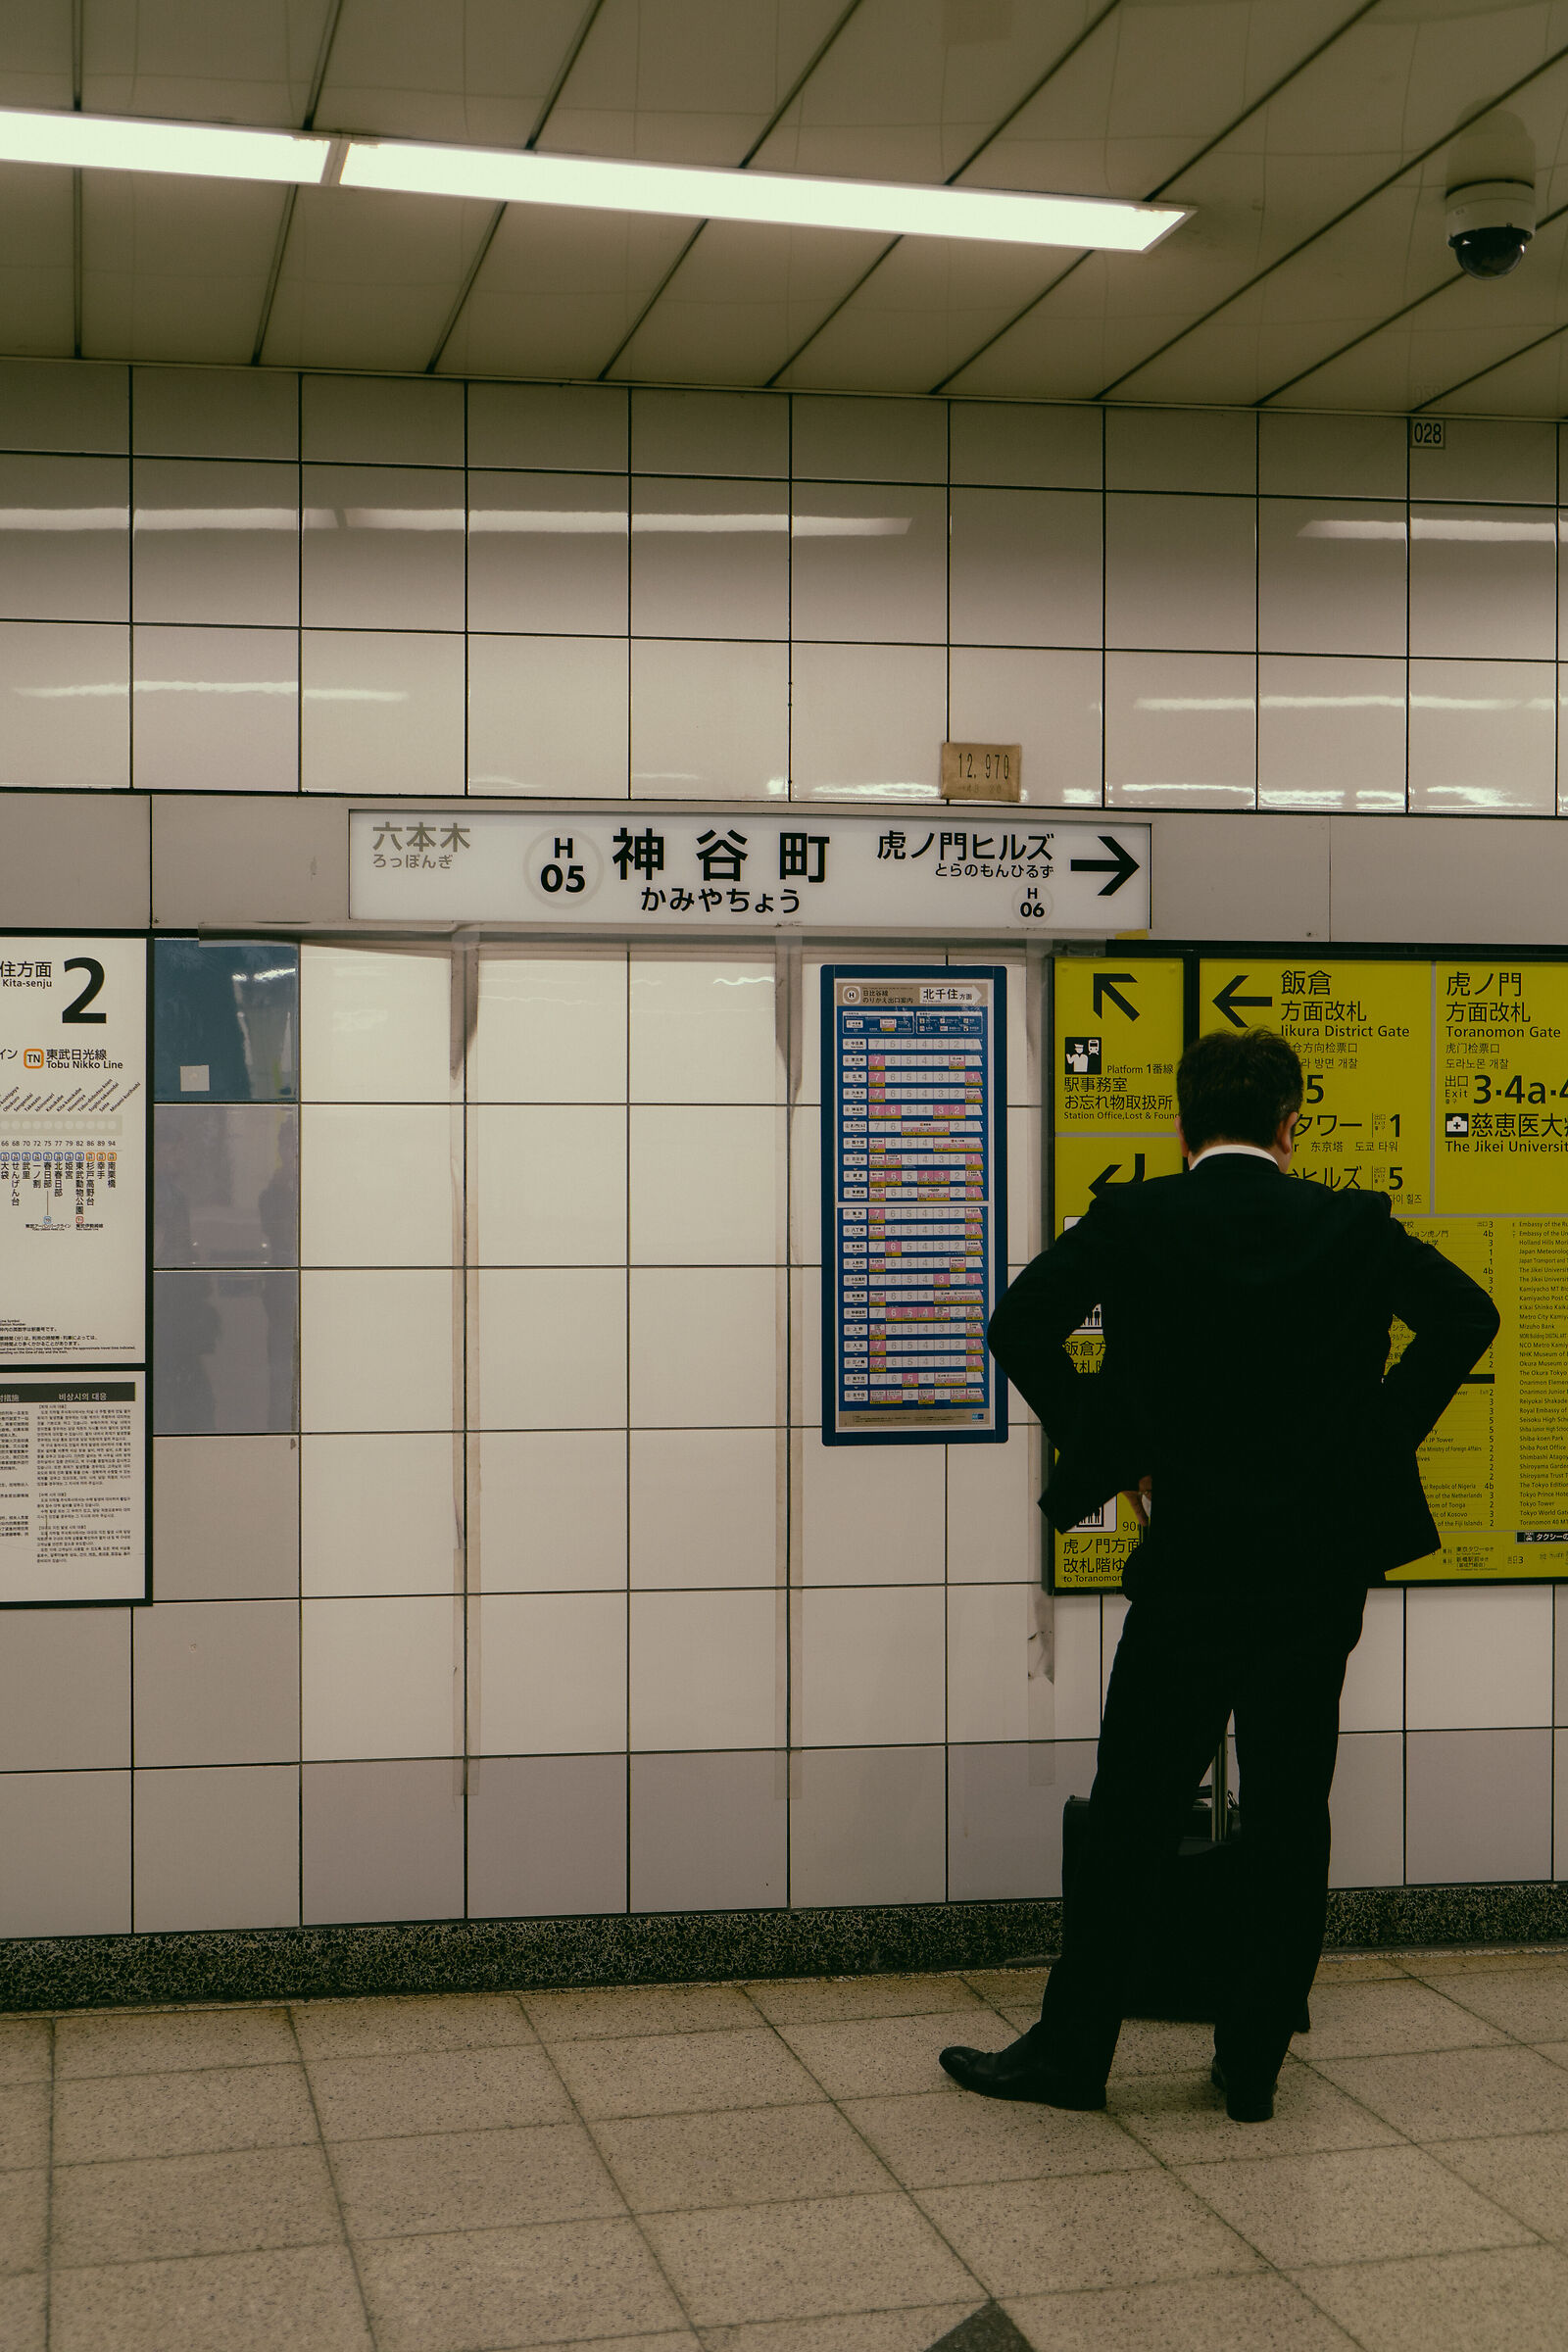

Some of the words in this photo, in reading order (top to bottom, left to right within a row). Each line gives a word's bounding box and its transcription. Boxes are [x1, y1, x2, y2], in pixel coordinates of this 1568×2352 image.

[1414, 422, 1442, 444] 028
[372, 821, 470, 853] 六本木
[554, 838, 573, 858] H
[877, 830, 1054, 860] 虎ノ門ヒルズ
[372, 854, 453, 869] ろっぽんぎ
[612, 827, 830, 883] 神谷町
[935, 863, 1054, 878] とらのもんひるず
[541, 864, 585, 893] 05
[641, 887, 800, 913] かみやちょう
[1028, 888, 1038, 899] H
[1020, 902, 1045, 917] 06
[0, 960, 52, 977] 住方面
[2, 979, 52, 989] Kita-senju
[63, 957, 107, 1023] 2
[1281, 970, 1332, 995] 飯倉
[1446, 971, 1522, 997] 虎ノ門
[923, 989, 957, 1000] 北千住
[1281, 1001, 1367, 1022] 方面改札
[1446, 1002, 1531, 1022] 方面改札
[1281, 1025, 1319, 1037] Iikura
[1325, 1025, 1373, 1037] District
[1378, 1026, 1410, 1037] Gate
[1446, 1026, 1524, 1038] Toranomon
[1530, 1026, 1561, 1038] Gate
[46, 1049, 107, 1060] 東武日光線
[1446, 1043, 1499, 1054] 虎门检票口
[27, 1054, 41, 1063] TN
[46, 1060, 70, 1069] Tobu
[73, 1060, 100, 1069] Nikko
[104, 1060, 122, 1069] Line
[1314, 1058, 1334, 1069] 방면
[1338, 1058, 1358, 1069] 개찰
[1446, 1058, 1486, 1069] 도라노몬
[1490, 1058, 1508, 1070] 개찰
[1107, 1065, 1143, 1074] Platform
[1064, 1077, 1128, 1092] 駅事務室
[1446, 1075, 1468, 1087] 出口
[1306, 1075, 1324, 1103] 5
[1064, 1095, 1173, 1110] お忘れ物取扱所
[1390, 1113, 1400, 1137] 1
[1471, 1113, 1568, 1138] 慈恵医大
[1311, 1142, 1344, 1152] 东京塔
[1379, 1141, 1397, 1152] 타워
[1446, 1141, 1469, 1152] The
[1474, 1141, 1503, 1152] Jikei
[1389, 1167, 1403, 1190] 5
